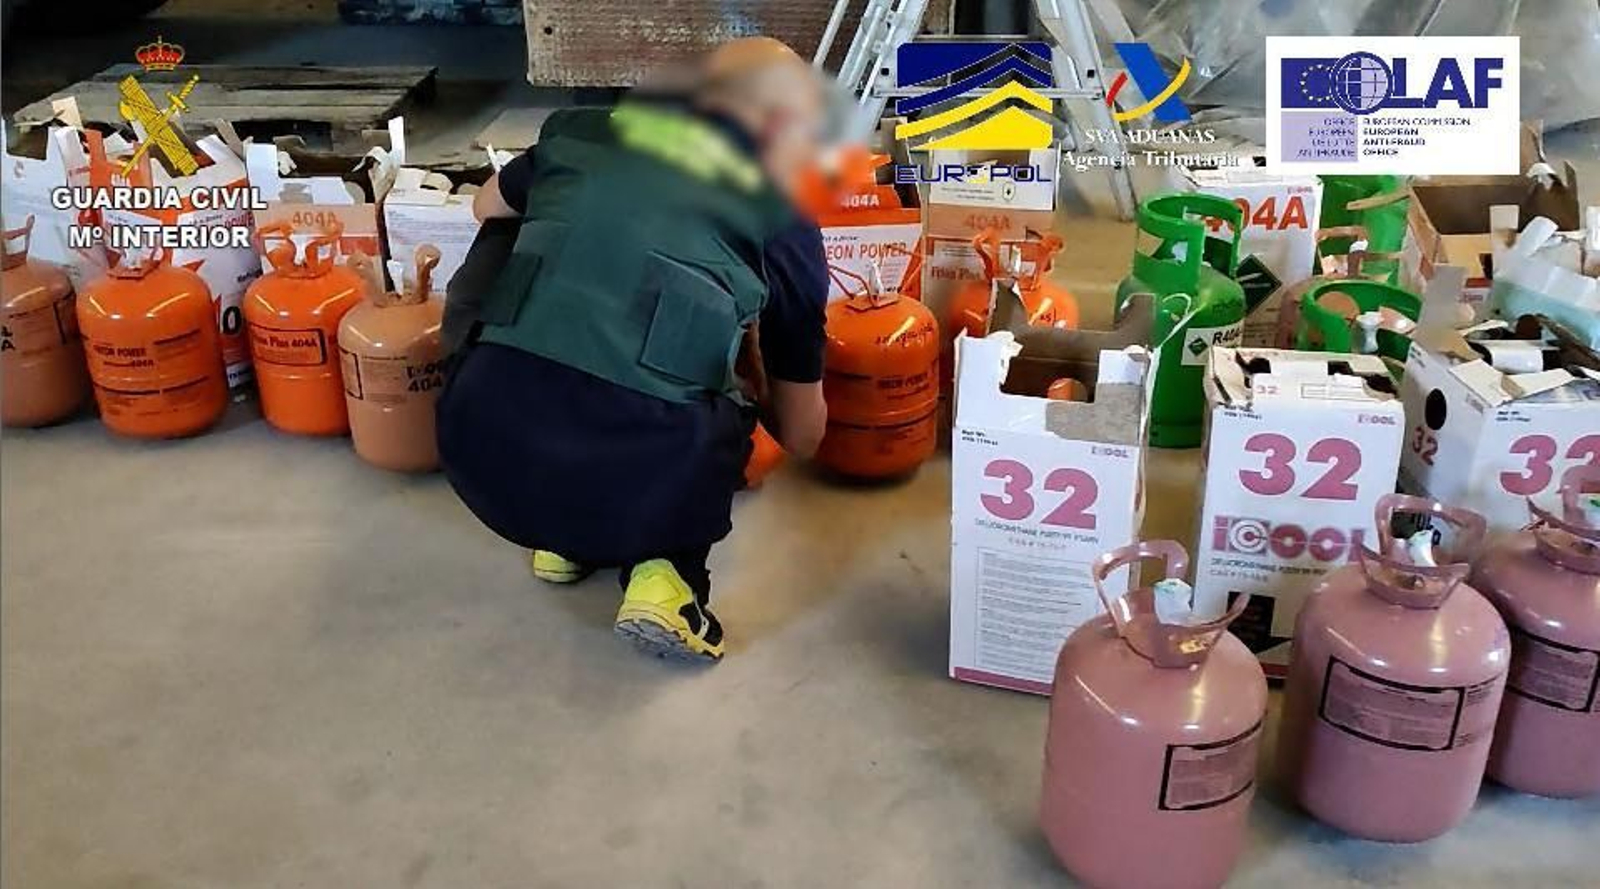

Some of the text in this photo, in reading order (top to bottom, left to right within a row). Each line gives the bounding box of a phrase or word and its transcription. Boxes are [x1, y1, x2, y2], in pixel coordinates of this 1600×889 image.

[291, 336, 318, 349] 404A
[980, 459, 1099, 530] 32
[1240, 432, 1362, 501] 32
[1500, 433, 1600, 495] 32
